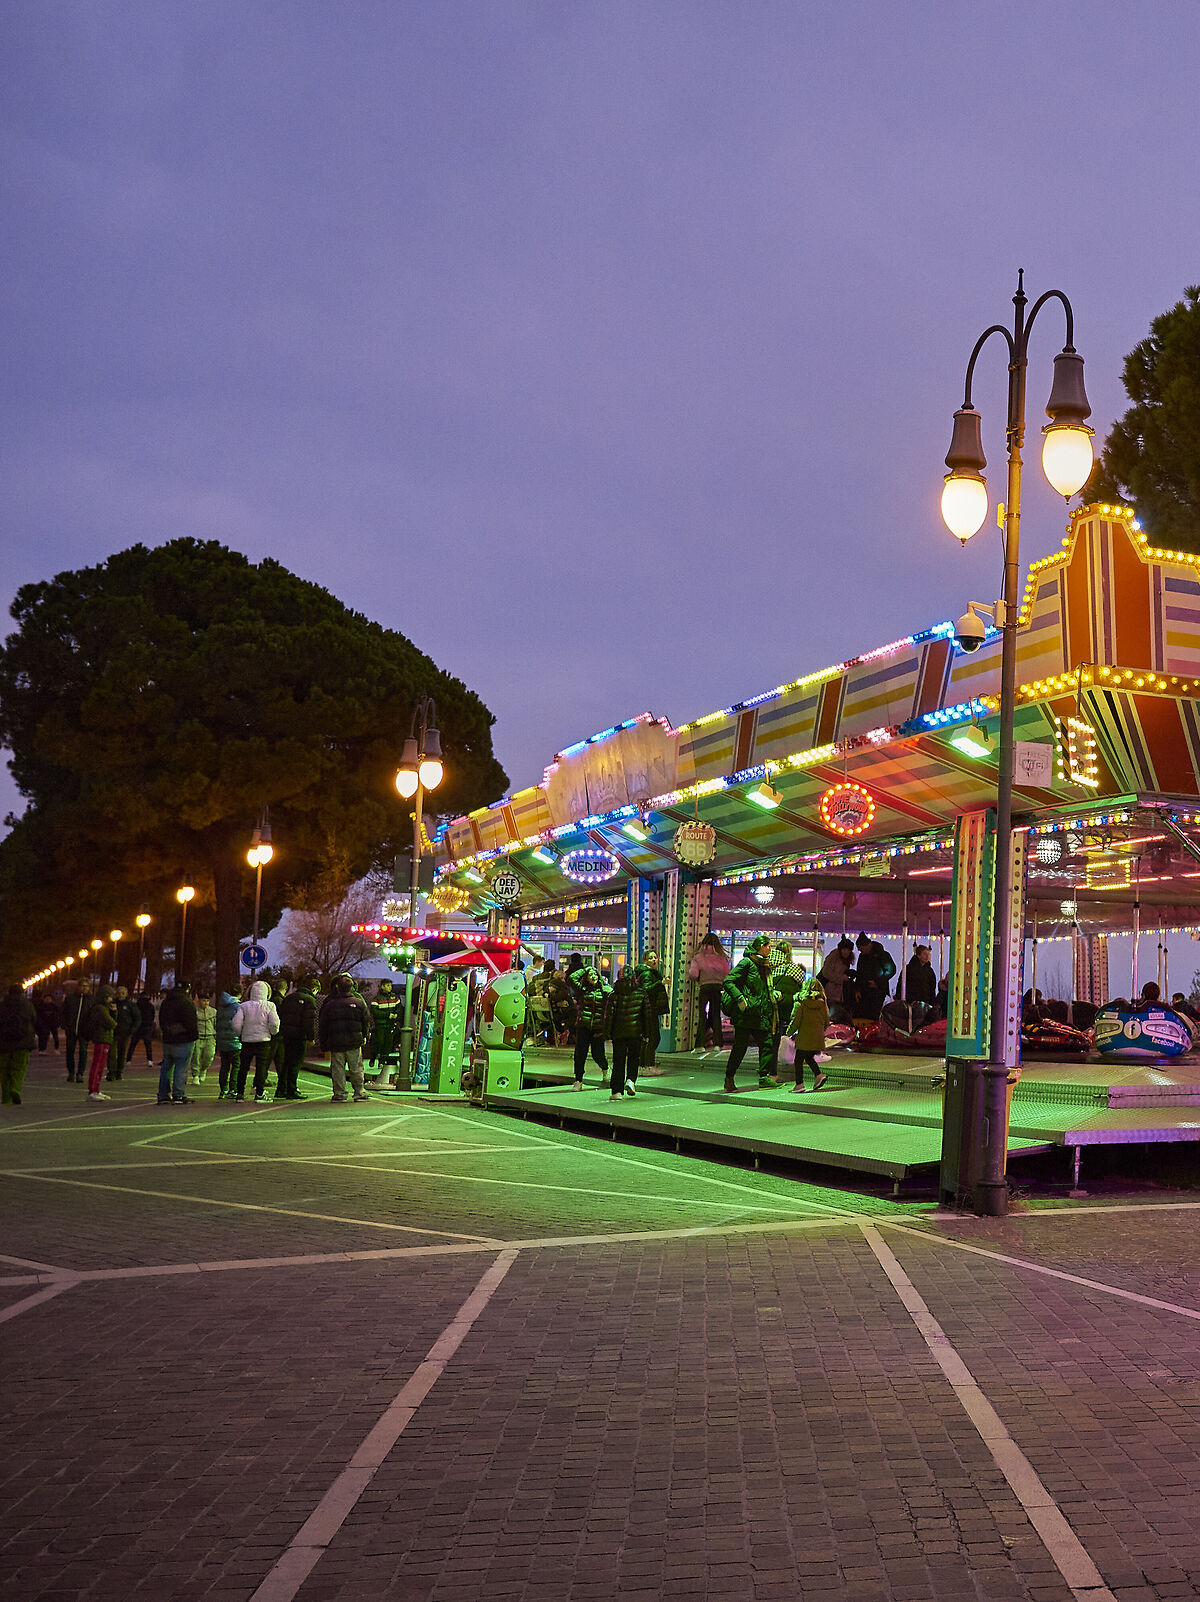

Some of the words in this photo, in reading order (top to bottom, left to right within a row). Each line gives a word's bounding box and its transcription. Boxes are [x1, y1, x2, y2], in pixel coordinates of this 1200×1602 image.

[685, 832, 707, 840] ROUTE
[686, 843, 706, 857] 66
[568, 861, 614, 872] MEDINI
[499, 878, 516, 887] DEE
[498, 887, 515, 895] JAY
[447, 993, 461, 1068] BOXER
[1151, 1036, 1175, 1048] facebook
